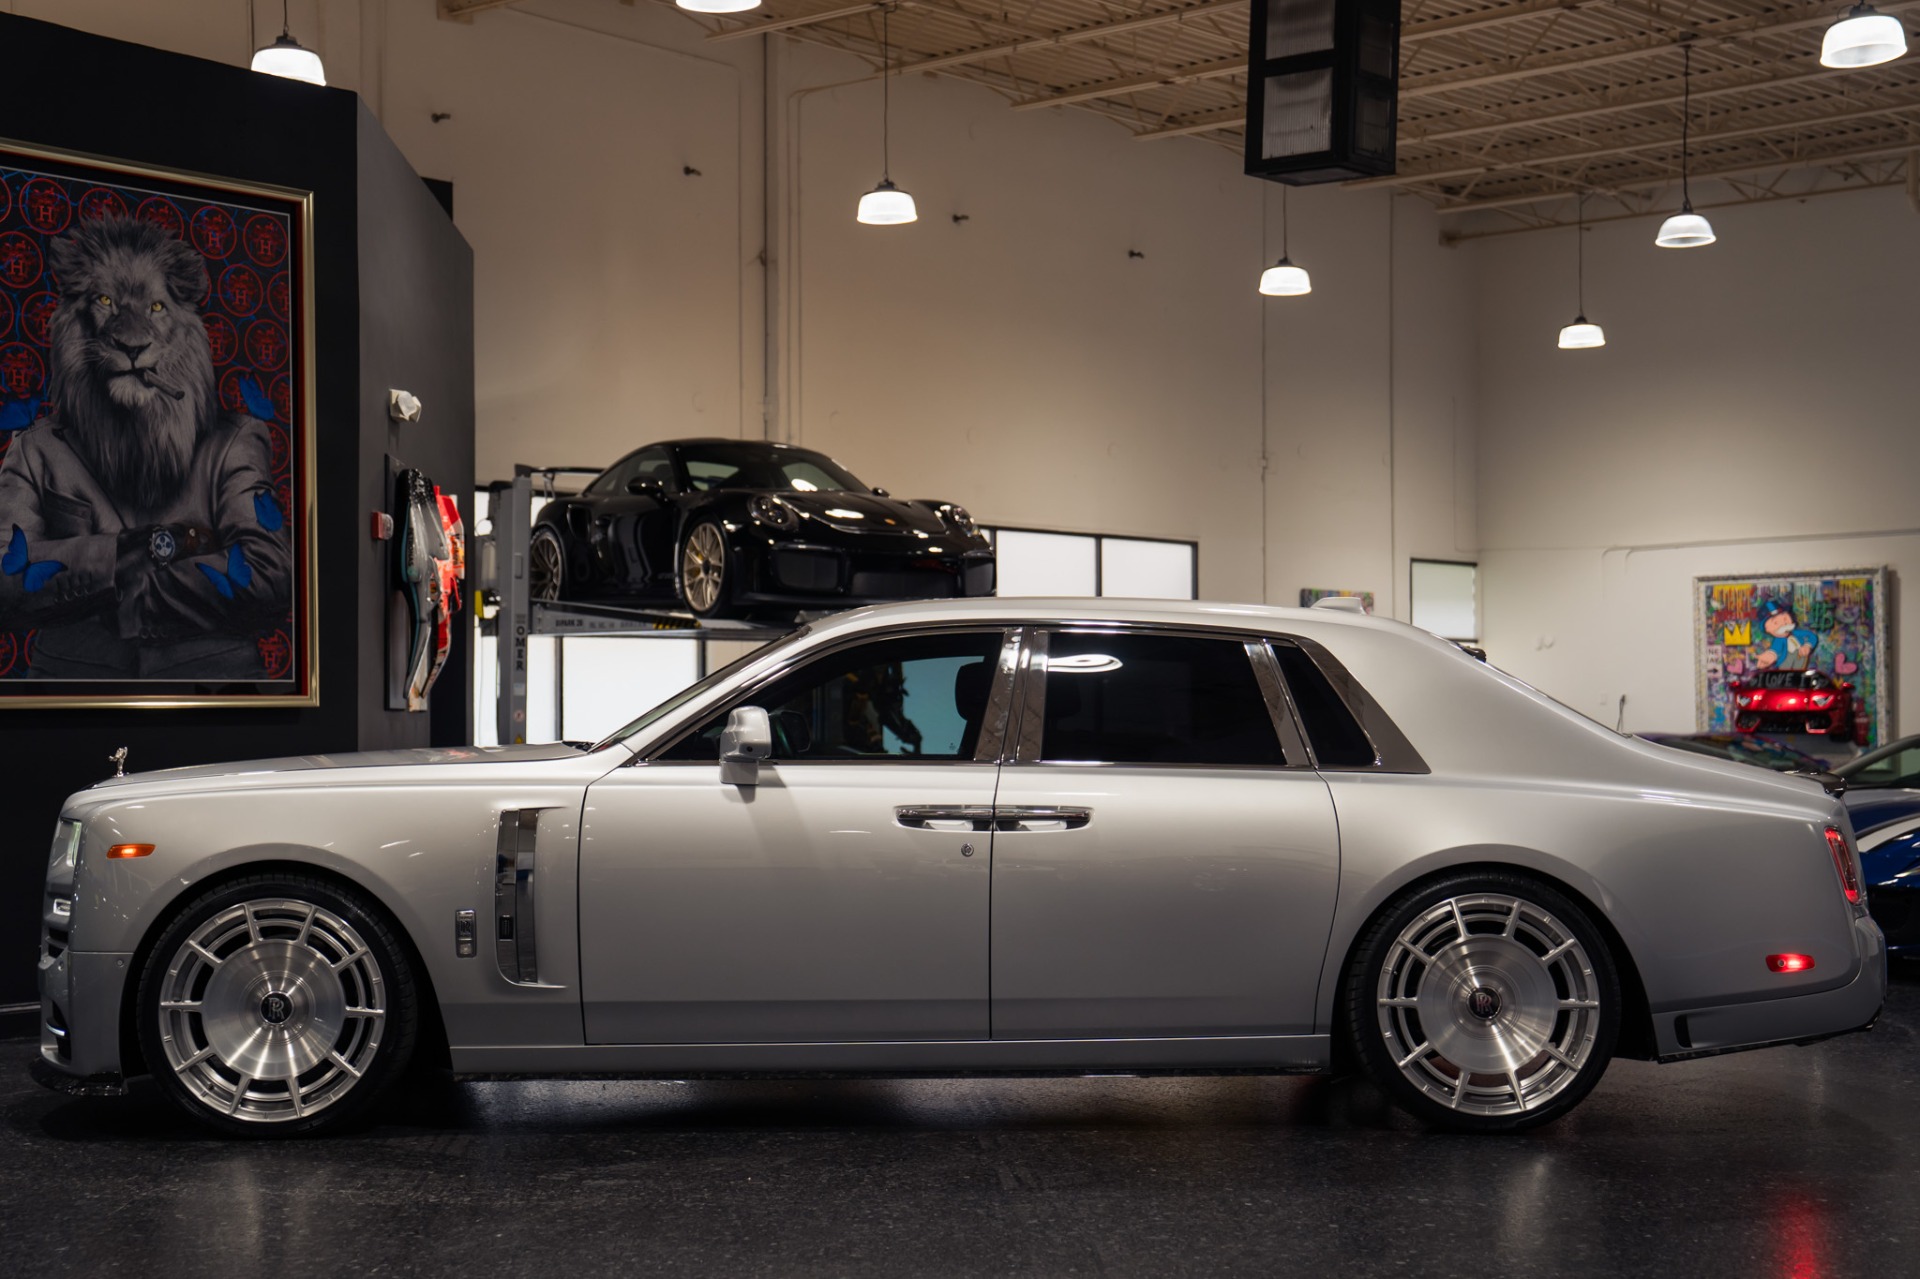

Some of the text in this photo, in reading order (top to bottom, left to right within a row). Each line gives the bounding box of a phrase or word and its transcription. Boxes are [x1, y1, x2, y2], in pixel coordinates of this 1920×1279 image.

[38, 205, 53, 222] H
[207, 232, 221, 248] H
[259, 240, 273, 255] H
[9, 259, 25, 276] H
[234, 290, 248, 305] H
[260, 344, 275, 360] H
[12, 369, 26, 386] H
[515, 625, 526, 671] OMER
[263, 652, 277, 668] H
[1765, 672, 1794, 688] LOVE
